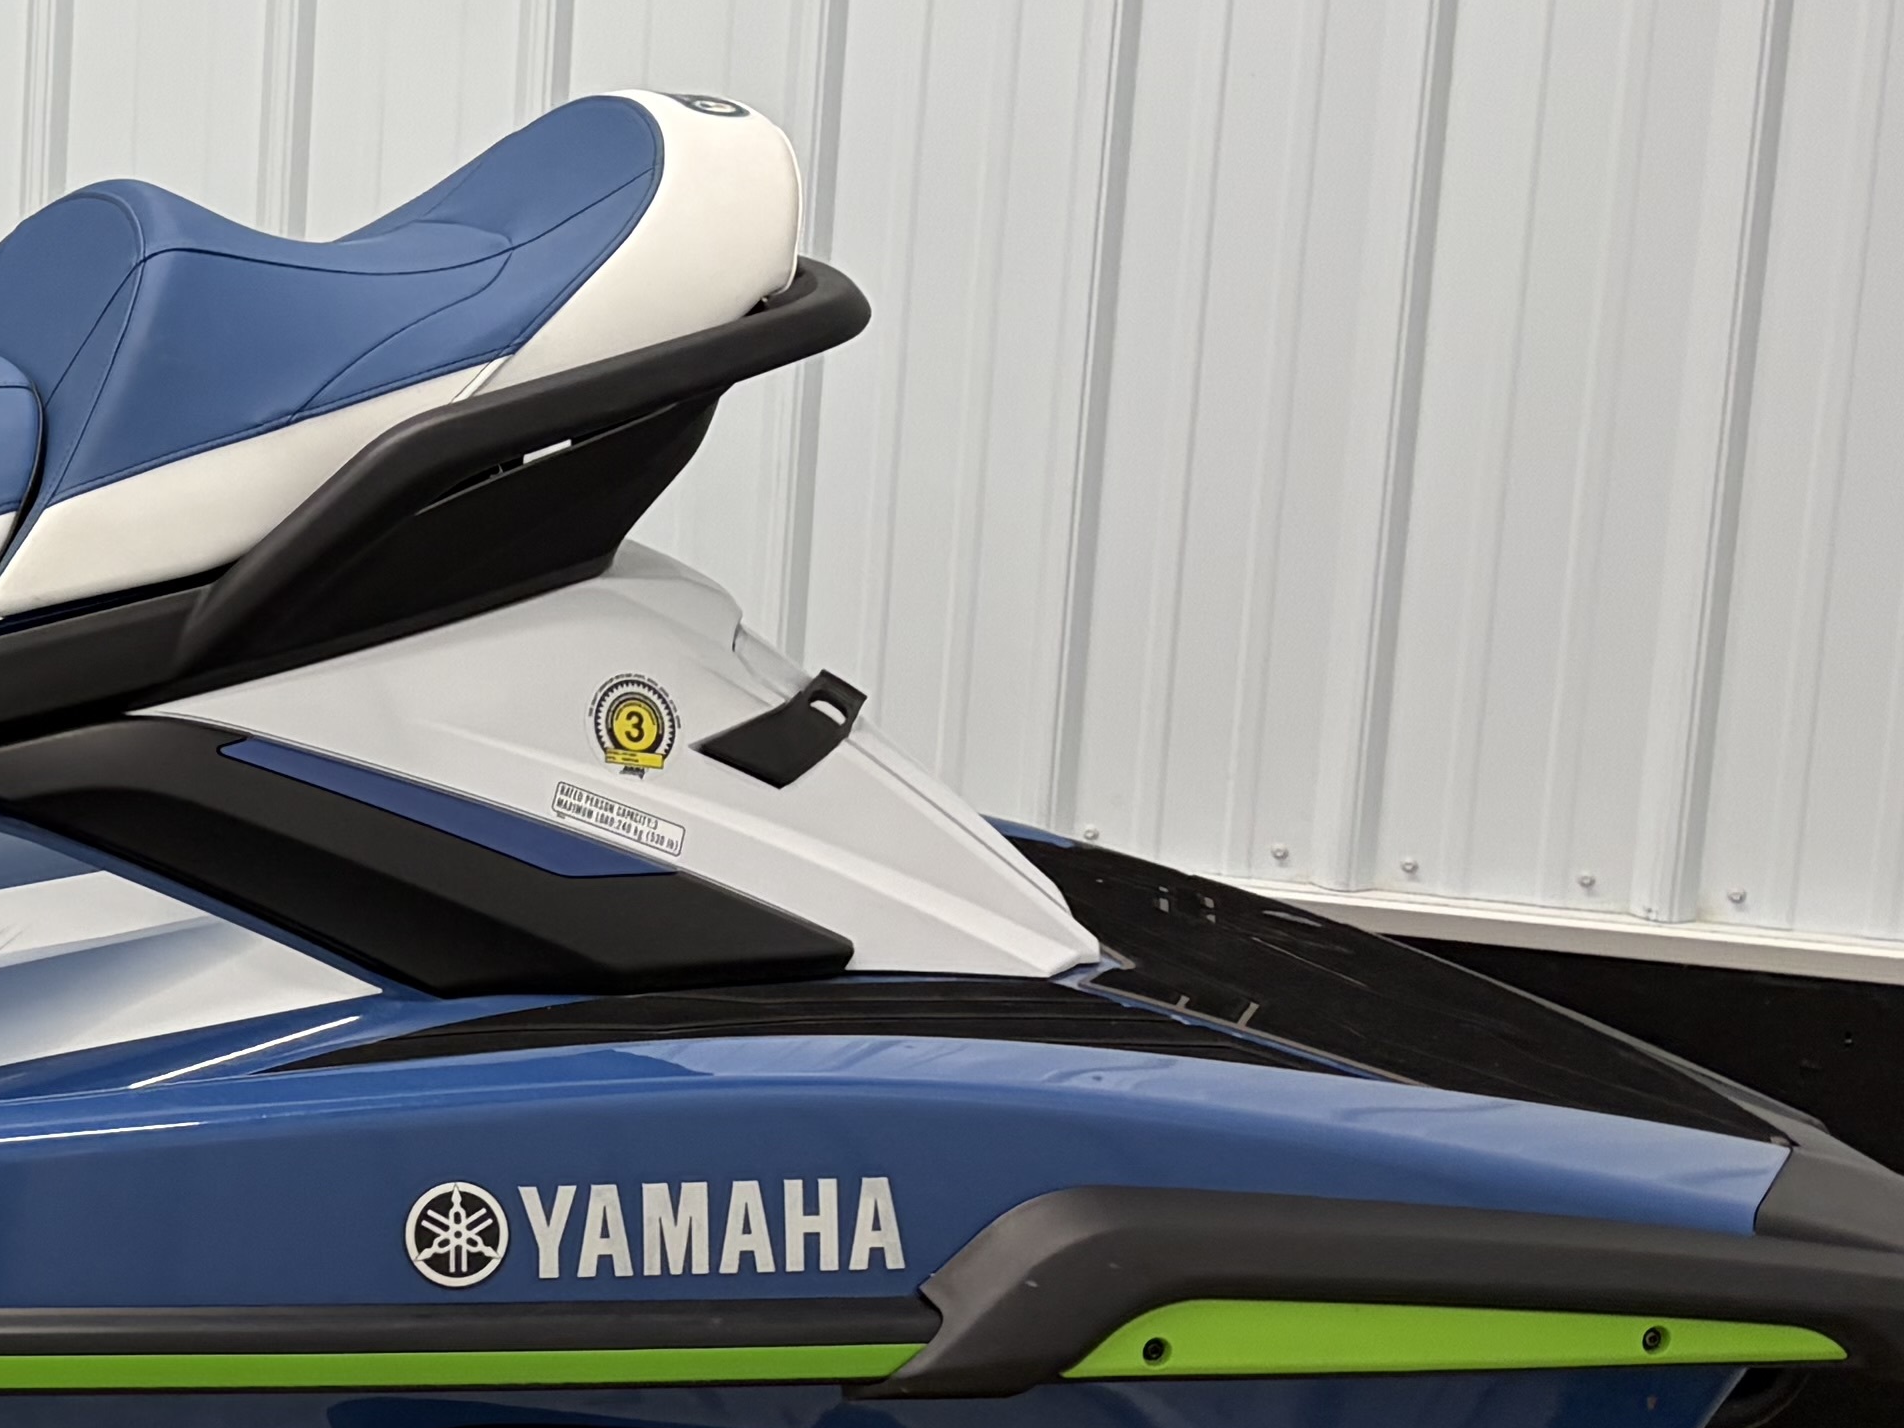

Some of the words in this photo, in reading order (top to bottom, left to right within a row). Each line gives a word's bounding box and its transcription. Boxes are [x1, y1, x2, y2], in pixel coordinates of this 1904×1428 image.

[624, 710, 645, 743] 3
[556, 797, 594, 819] MAXIMUM
[584, 794, 615, 814] PERSON
[517, 1176, 906, 1279] YAMAHA
